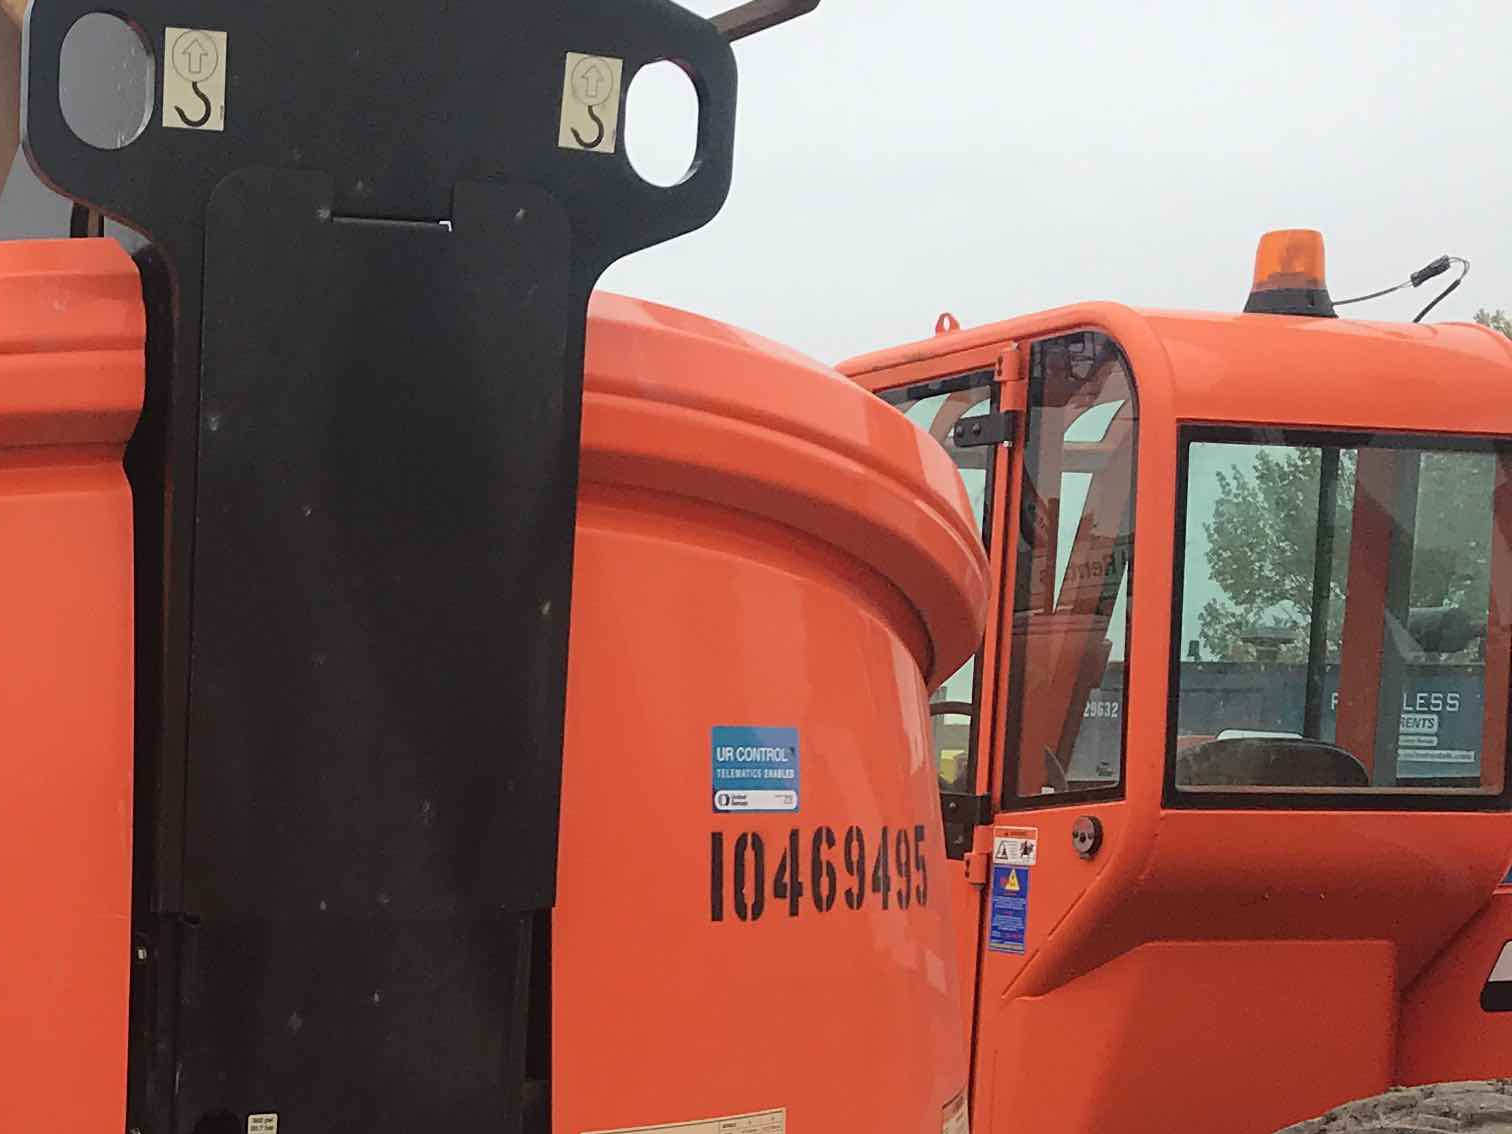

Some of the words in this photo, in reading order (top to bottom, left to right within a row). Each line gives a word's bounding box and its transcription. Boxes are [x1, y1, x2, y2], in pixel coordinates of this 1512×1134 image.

[716, 747, 734, 762] UR
[736, 747, 789, 763] CONTROL
[716, 768, 762, 779] TELEMATICS
[763, 768, 795, 779] ENABLED
